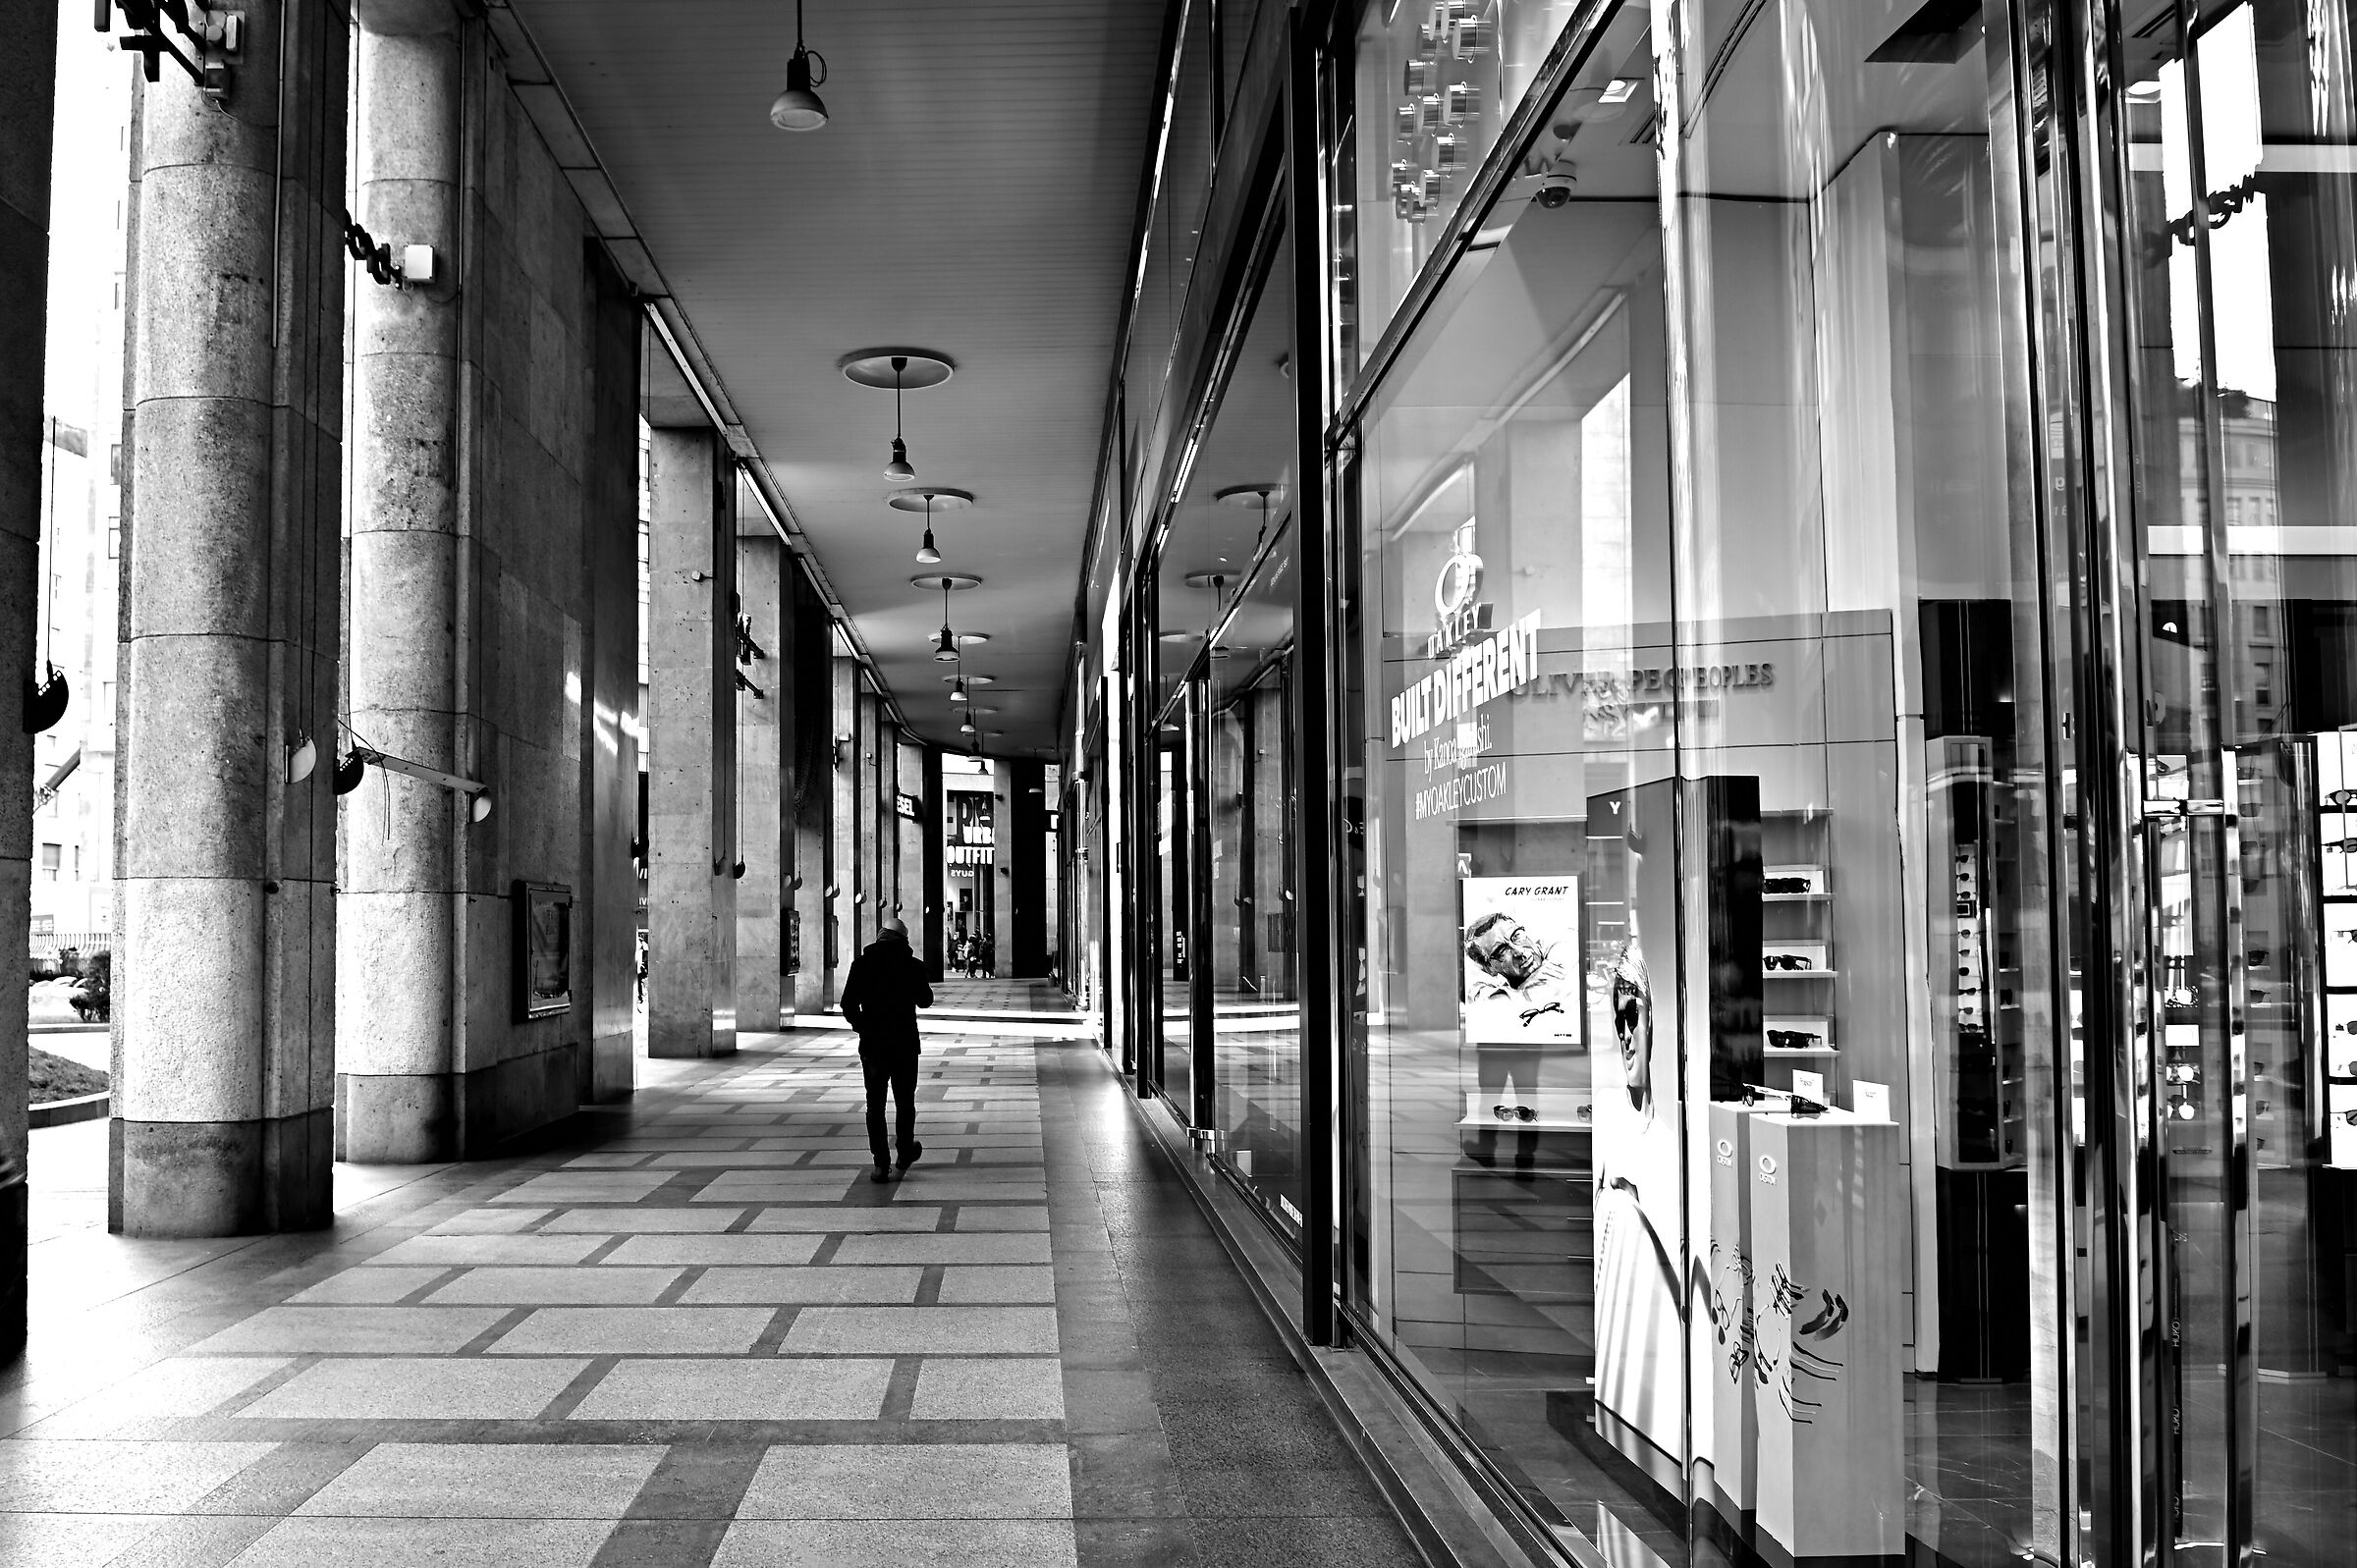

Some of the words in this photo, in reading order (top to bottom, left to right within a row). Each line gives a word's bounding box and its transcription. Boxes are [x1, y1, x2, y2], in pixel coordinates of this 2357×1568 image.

[1428, 602, 1482, 659] OAKLEY
[1392, 675, 1432, 749] BUILT
[1433, 609, 1541, 728] DIFFERENT
[1424, 739, 1434, 783] by
[1434, 736, 1457, 770] Kanoa
[1415, 761, 1507, 821] #MYOAKLEYCUSTOM
[946, 845, 995, 865] OUTFIT
[1505, 887, 1532, 895] CARY
[1534, 886, 1569, 895] GRANT
